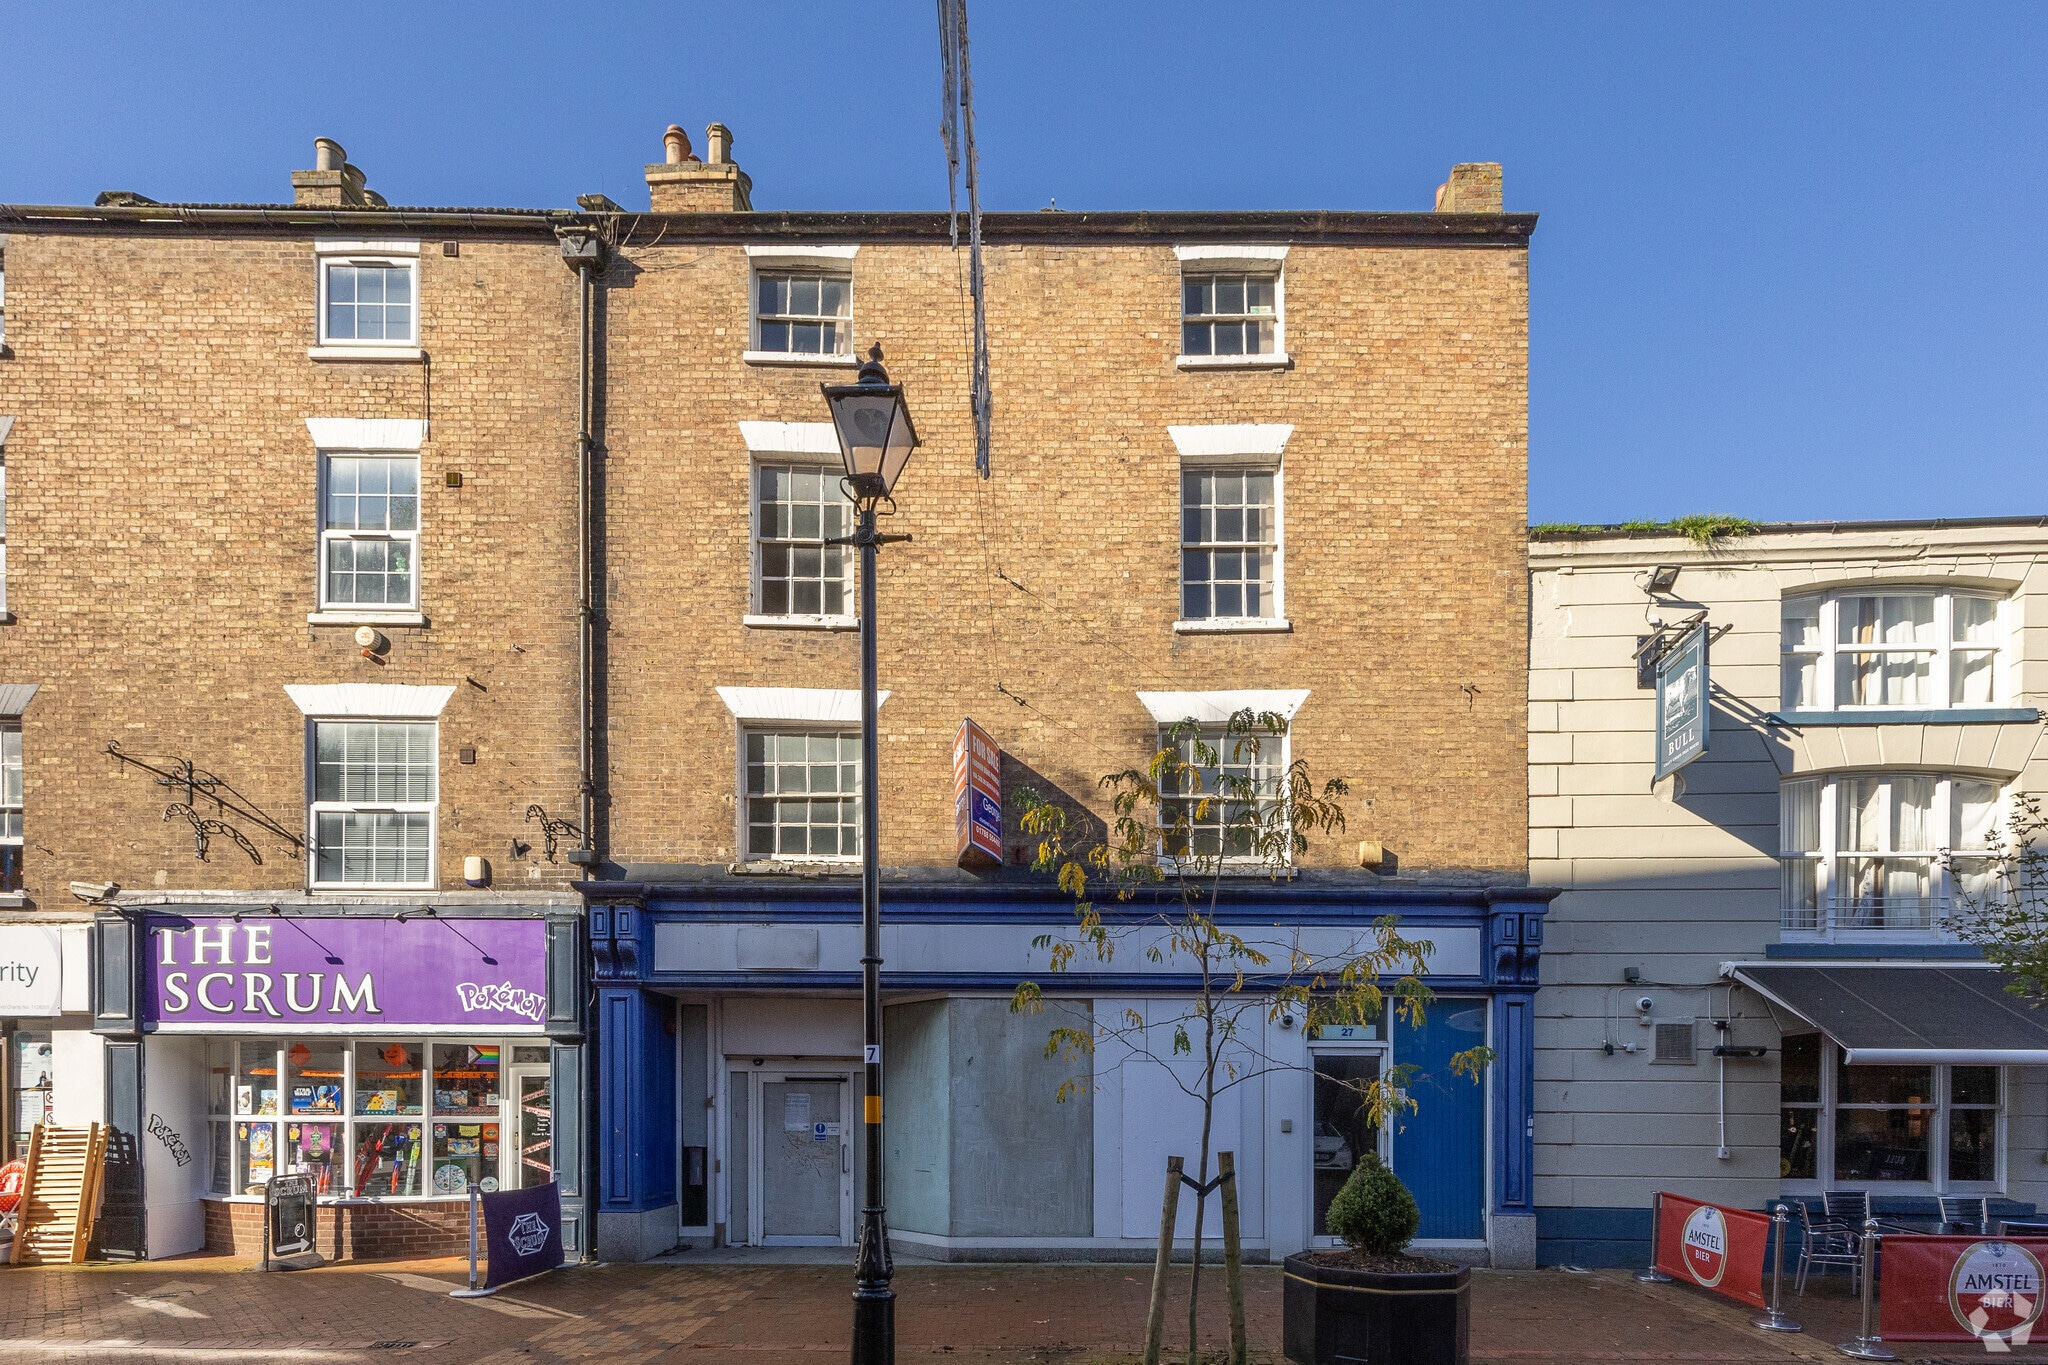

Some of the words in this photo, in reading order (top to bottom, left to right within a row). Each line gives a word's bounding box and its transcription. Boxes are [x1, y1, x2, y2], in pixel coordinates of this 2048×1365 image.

[1668, 727, 1695, 756] BULL
[972, 734, 986, 761] FOR
[986, 746, 999, 773] SALE
[982, 797, 1001, 822] Georg
[151, 924, 274, 966] THE
[163, 971, 384, 1018] SCRUM
[1341, 1028, 1354, 1037] 27
[866, 1047, 876, 1061] 7
[274, 1185, 308, 1197] SCRUM
[519, 1220, 537, 1235] THE
[513, 1232, 545, 1250] SCRUM
[1688, 1229, 1721, 1251] AMSTEL
[1695, 1249, 1711, 1263] BIER
[1964, 1273, 2033, 1291] AMSTEL
[1983, 1297, 2013, 1309] BIER
